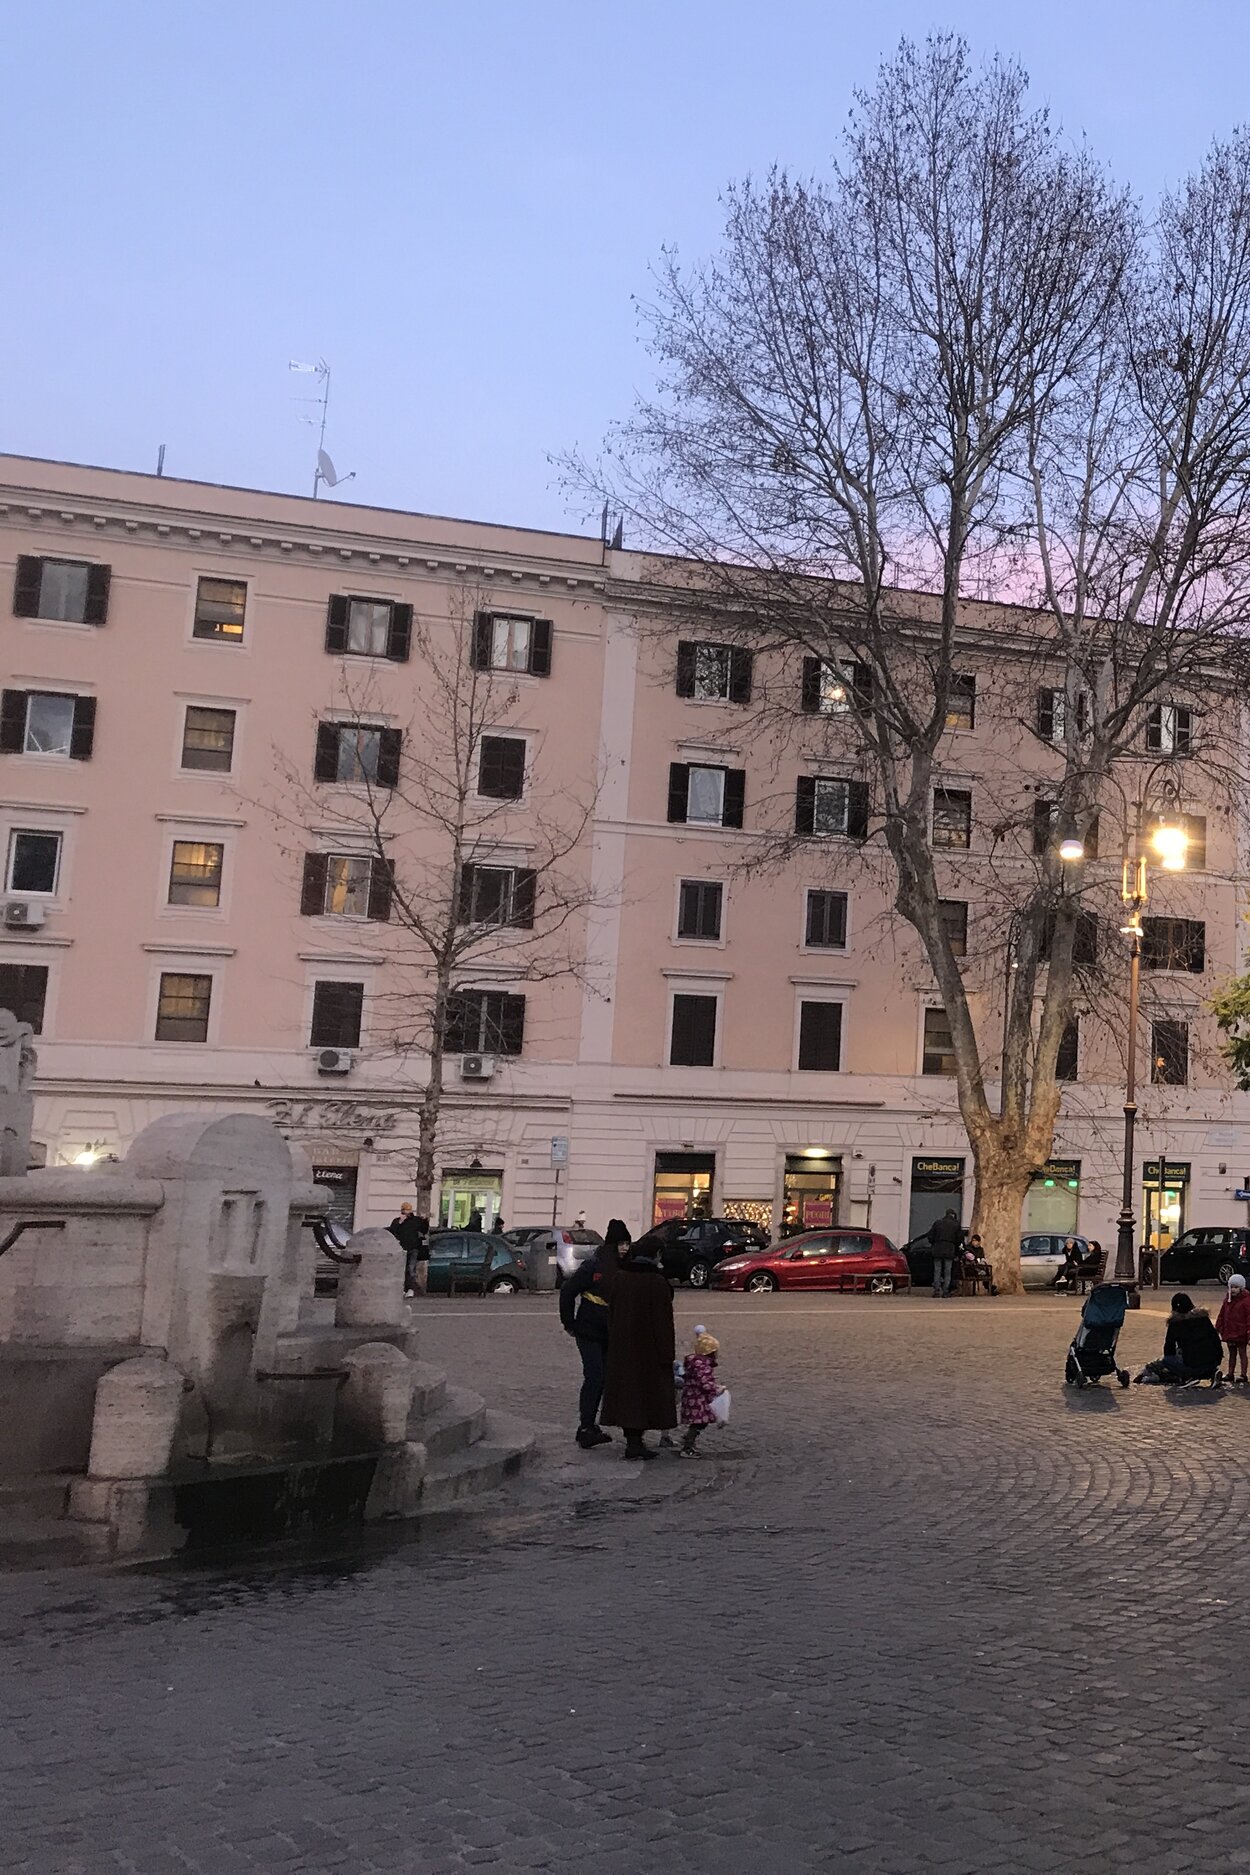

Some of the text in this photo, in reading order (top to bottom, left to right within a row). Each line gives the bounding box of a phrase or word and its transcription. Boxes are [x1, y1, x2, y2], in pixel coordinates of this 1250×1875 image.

[917, 1161, 960, 1171] CheBanca!
[1147, 1166, 1186, 1176] Chanca!
[315, 1170, 343, 1179] Elena
